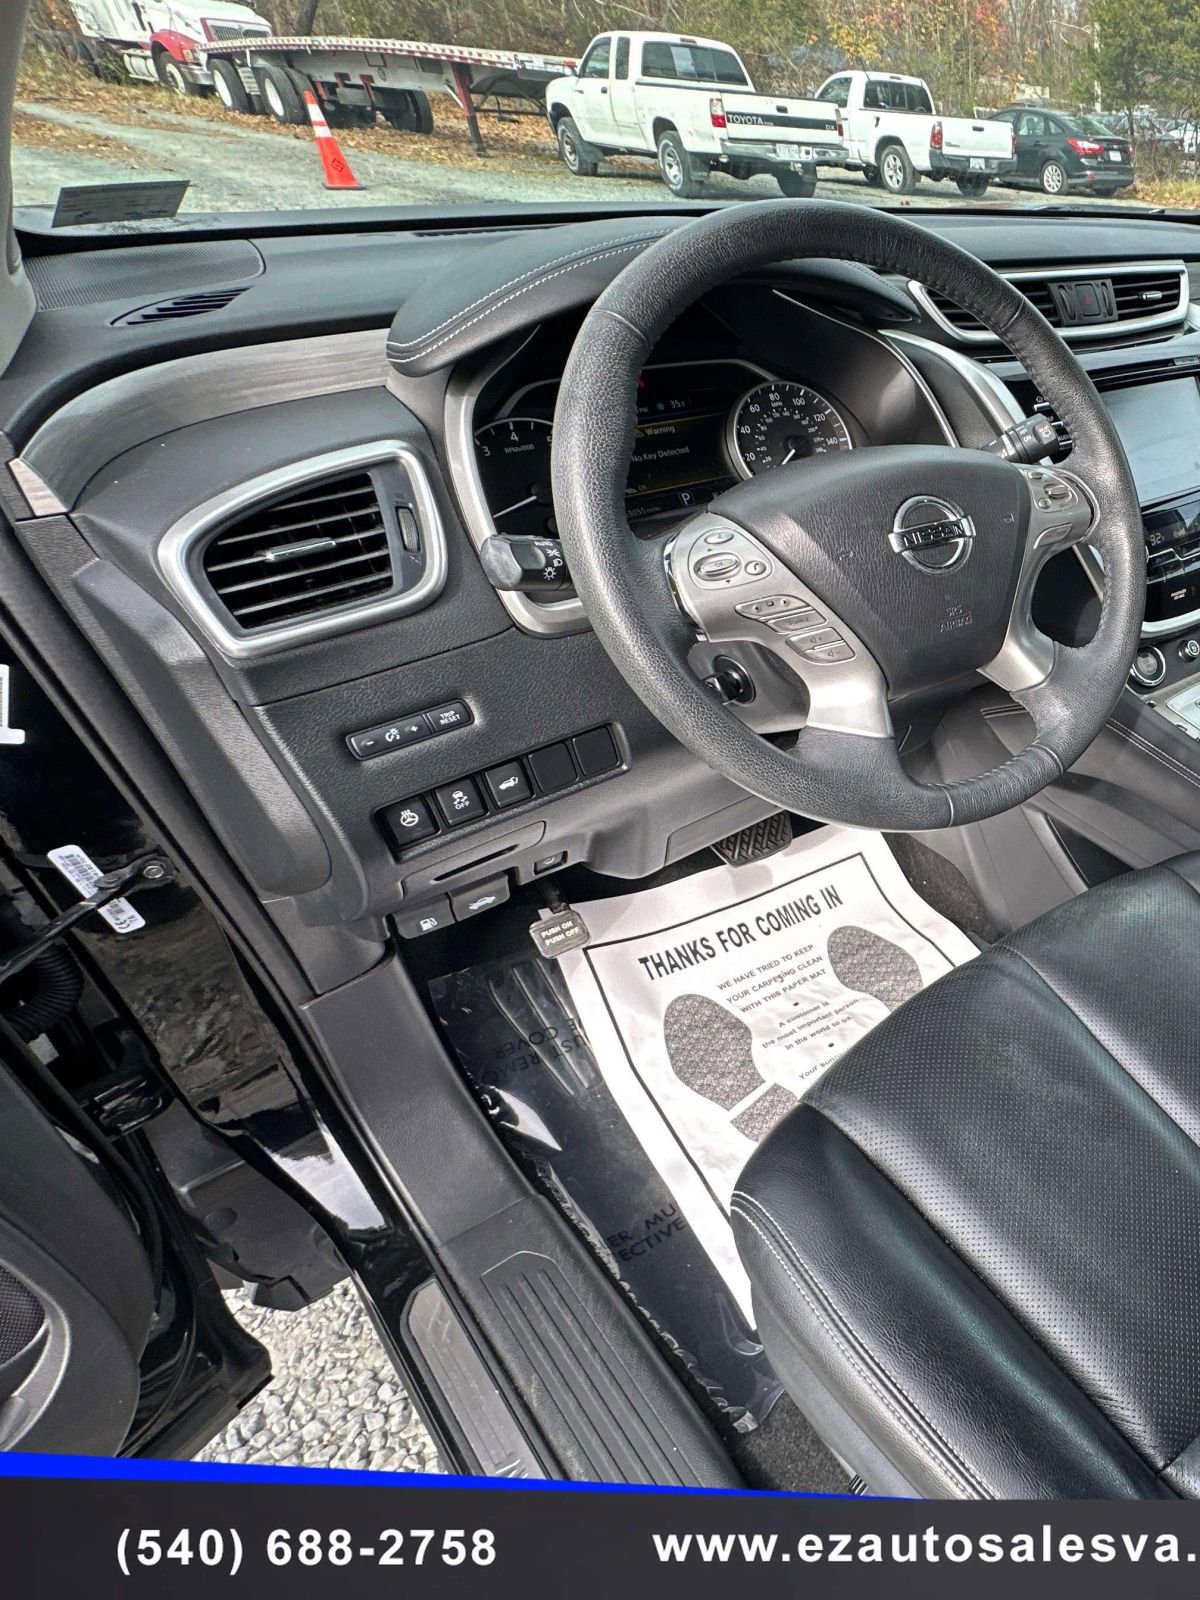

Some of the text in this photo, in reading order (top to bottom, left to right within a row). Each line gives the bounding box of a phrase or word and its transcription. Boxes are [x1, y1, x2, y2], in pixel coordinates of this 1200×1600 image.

[728, 114, 764, 126] TOYOTA
[768, 392, 780, 401] 80
[792, 397, 806, 406] 100
[749, 403, 760, 413] 60
[813, 413, 826, 422] 120
[645, 425, 676, 436] Warning
[740, 425, 751, 434] 40
[510, 431, 519, 442] 4
[826, 437, 838, 446] 140
[481, 446, 491, 457] 3
[643, 452, 657, 461] Key
[657, 445, 690, 458] Detected
[745, 452, 756, 462] 20
[681, 493, 691, 505] P
[903, 524, 964, 548] NISSAN
[440, 710, 455, 719] TRIP
[440, 714, 460, 725] RESET
[455, 800, 470, 810] OFF
[541, 921, 573, 938] PUSH ON
[638, 884, 843, 981] THANKS FOR COMING IN
[545, 926, 579, 946] PUSH OFF
[717, 944, 813, 990] WE HAVE TRIED TO KEEP
[726, 989, 751, 1004] YOUR
[797, 955, 823, 971] CLEAN
[740, 968, 827, 1013] WITH THIS PAPER MAT
[786, 1005, 820, 1024] customer
[762, 1039, 775, 1049] the
[777, 1028, 797, 1041] most
[797, 1011, 833, 1031] important
[794, 1036, 808, 1046] the
[809, 1025, 831, 1038] world
[482, 1051, 542, 1086] REMO
[799, 1065, 818, 1080] Your
